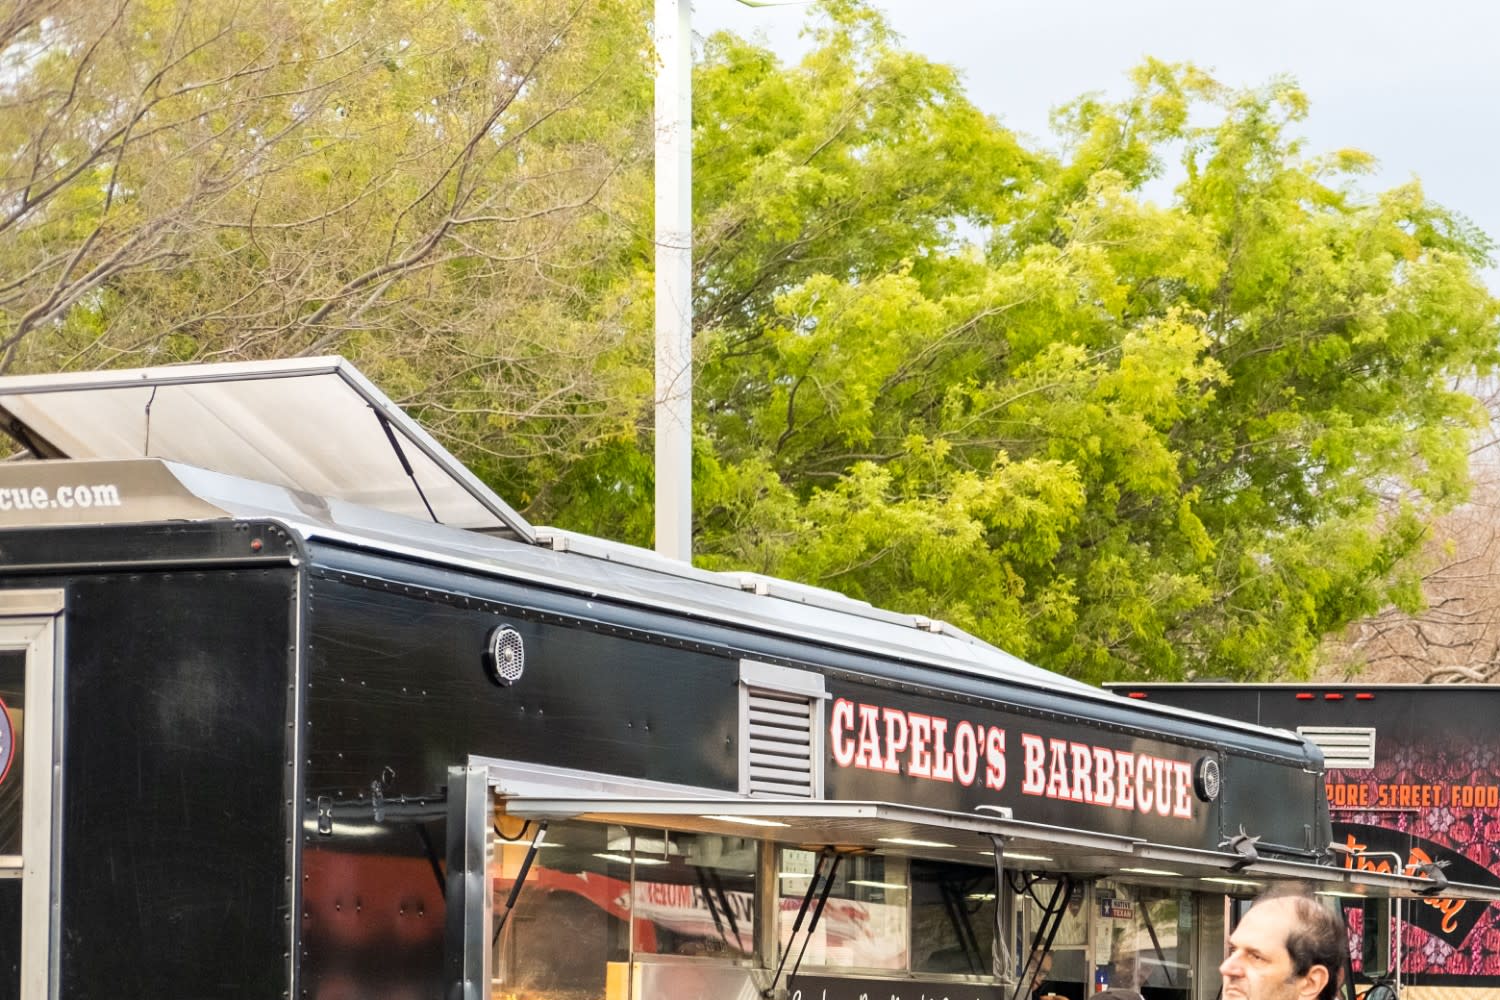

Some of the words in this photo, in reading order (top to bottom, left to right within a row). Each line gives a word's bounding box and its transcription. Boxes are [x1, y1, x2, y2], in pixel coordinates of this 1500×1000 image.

[830, 697, 1007, 791] CAPELO'S
[1021, 732, 1193, 819] BARBECUE
[1378, 784, 1442, 807] STREET
[1451, 785, 1499, 808] FOOD
[1112, 909, 1132, 918] TEXAN
